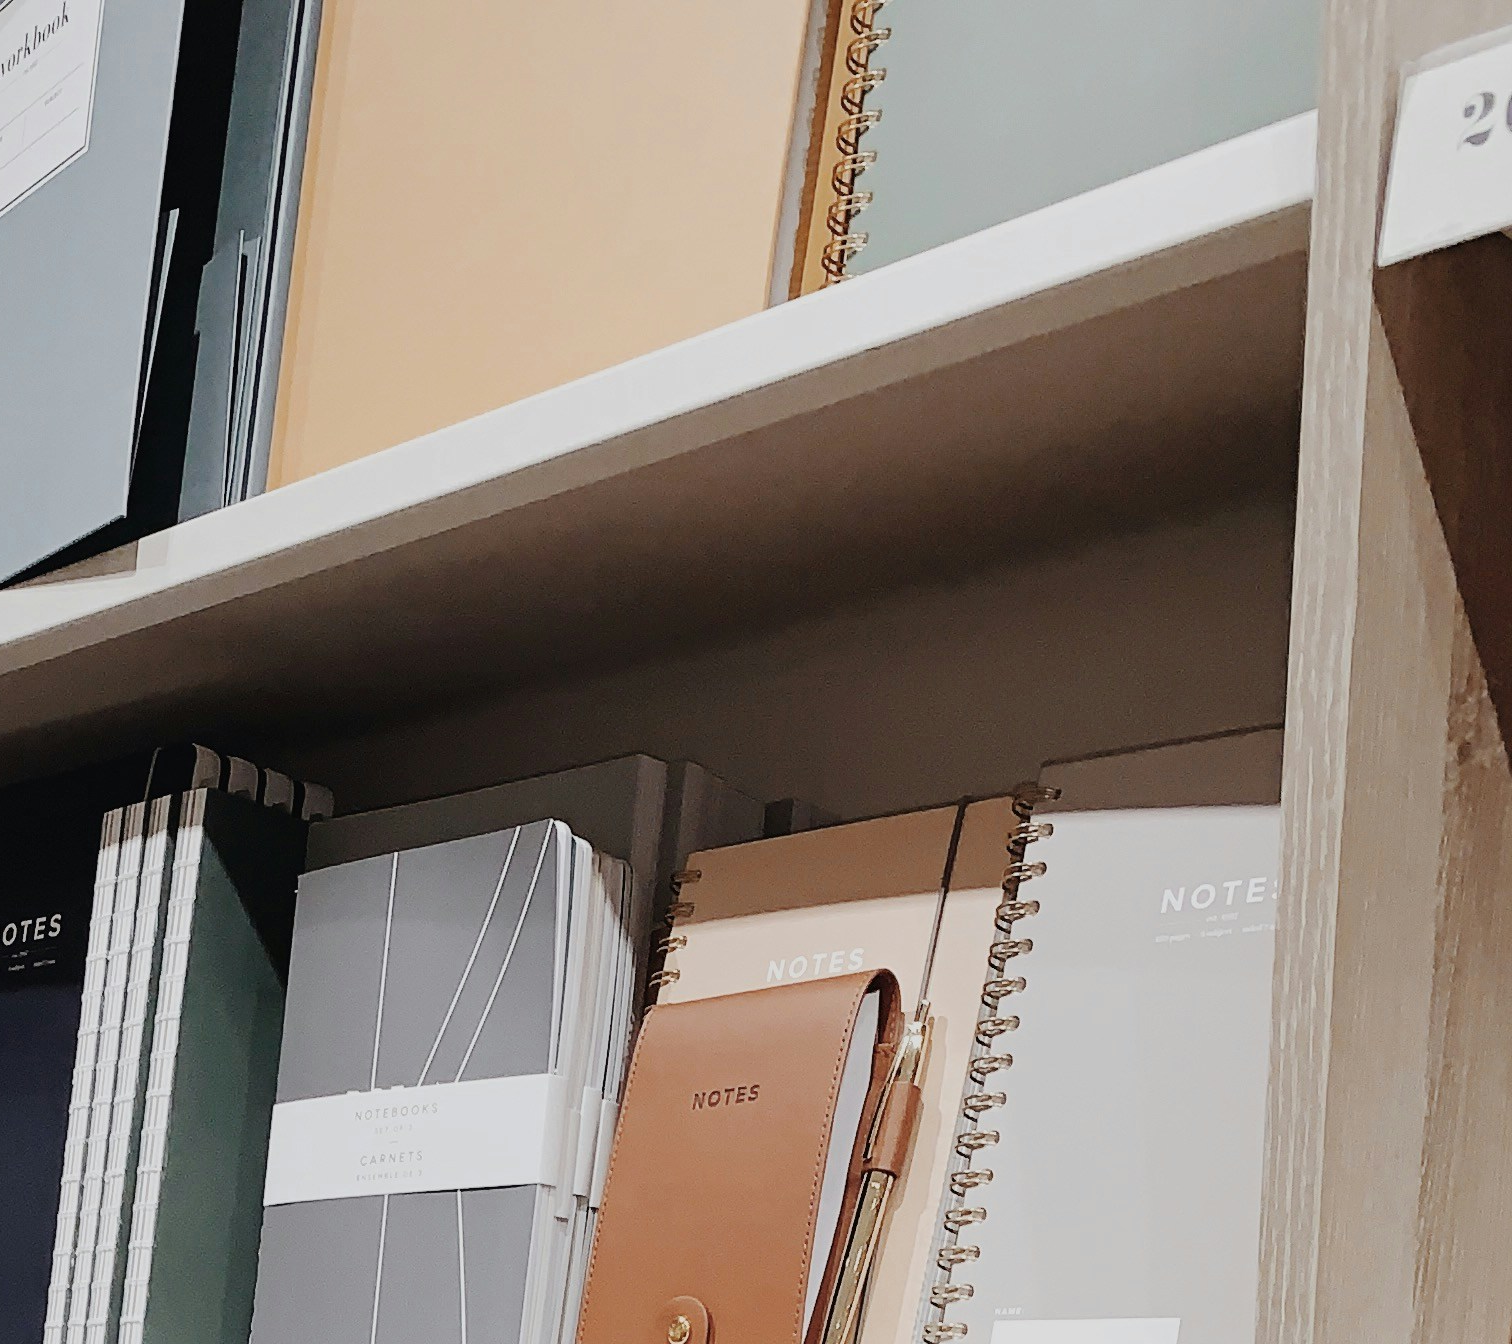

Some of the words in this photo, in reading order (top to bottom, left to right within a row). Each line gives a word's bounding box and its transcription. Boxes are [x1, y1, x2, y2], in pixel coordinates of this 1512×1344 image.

[766, 947, 865, 984] NOTES
[692, 1083, 761, 1111] NOTES
[355, 1102, 438, 1120] NOTEBOOKS
[360, 1151, 423, 1166] CARNETS
